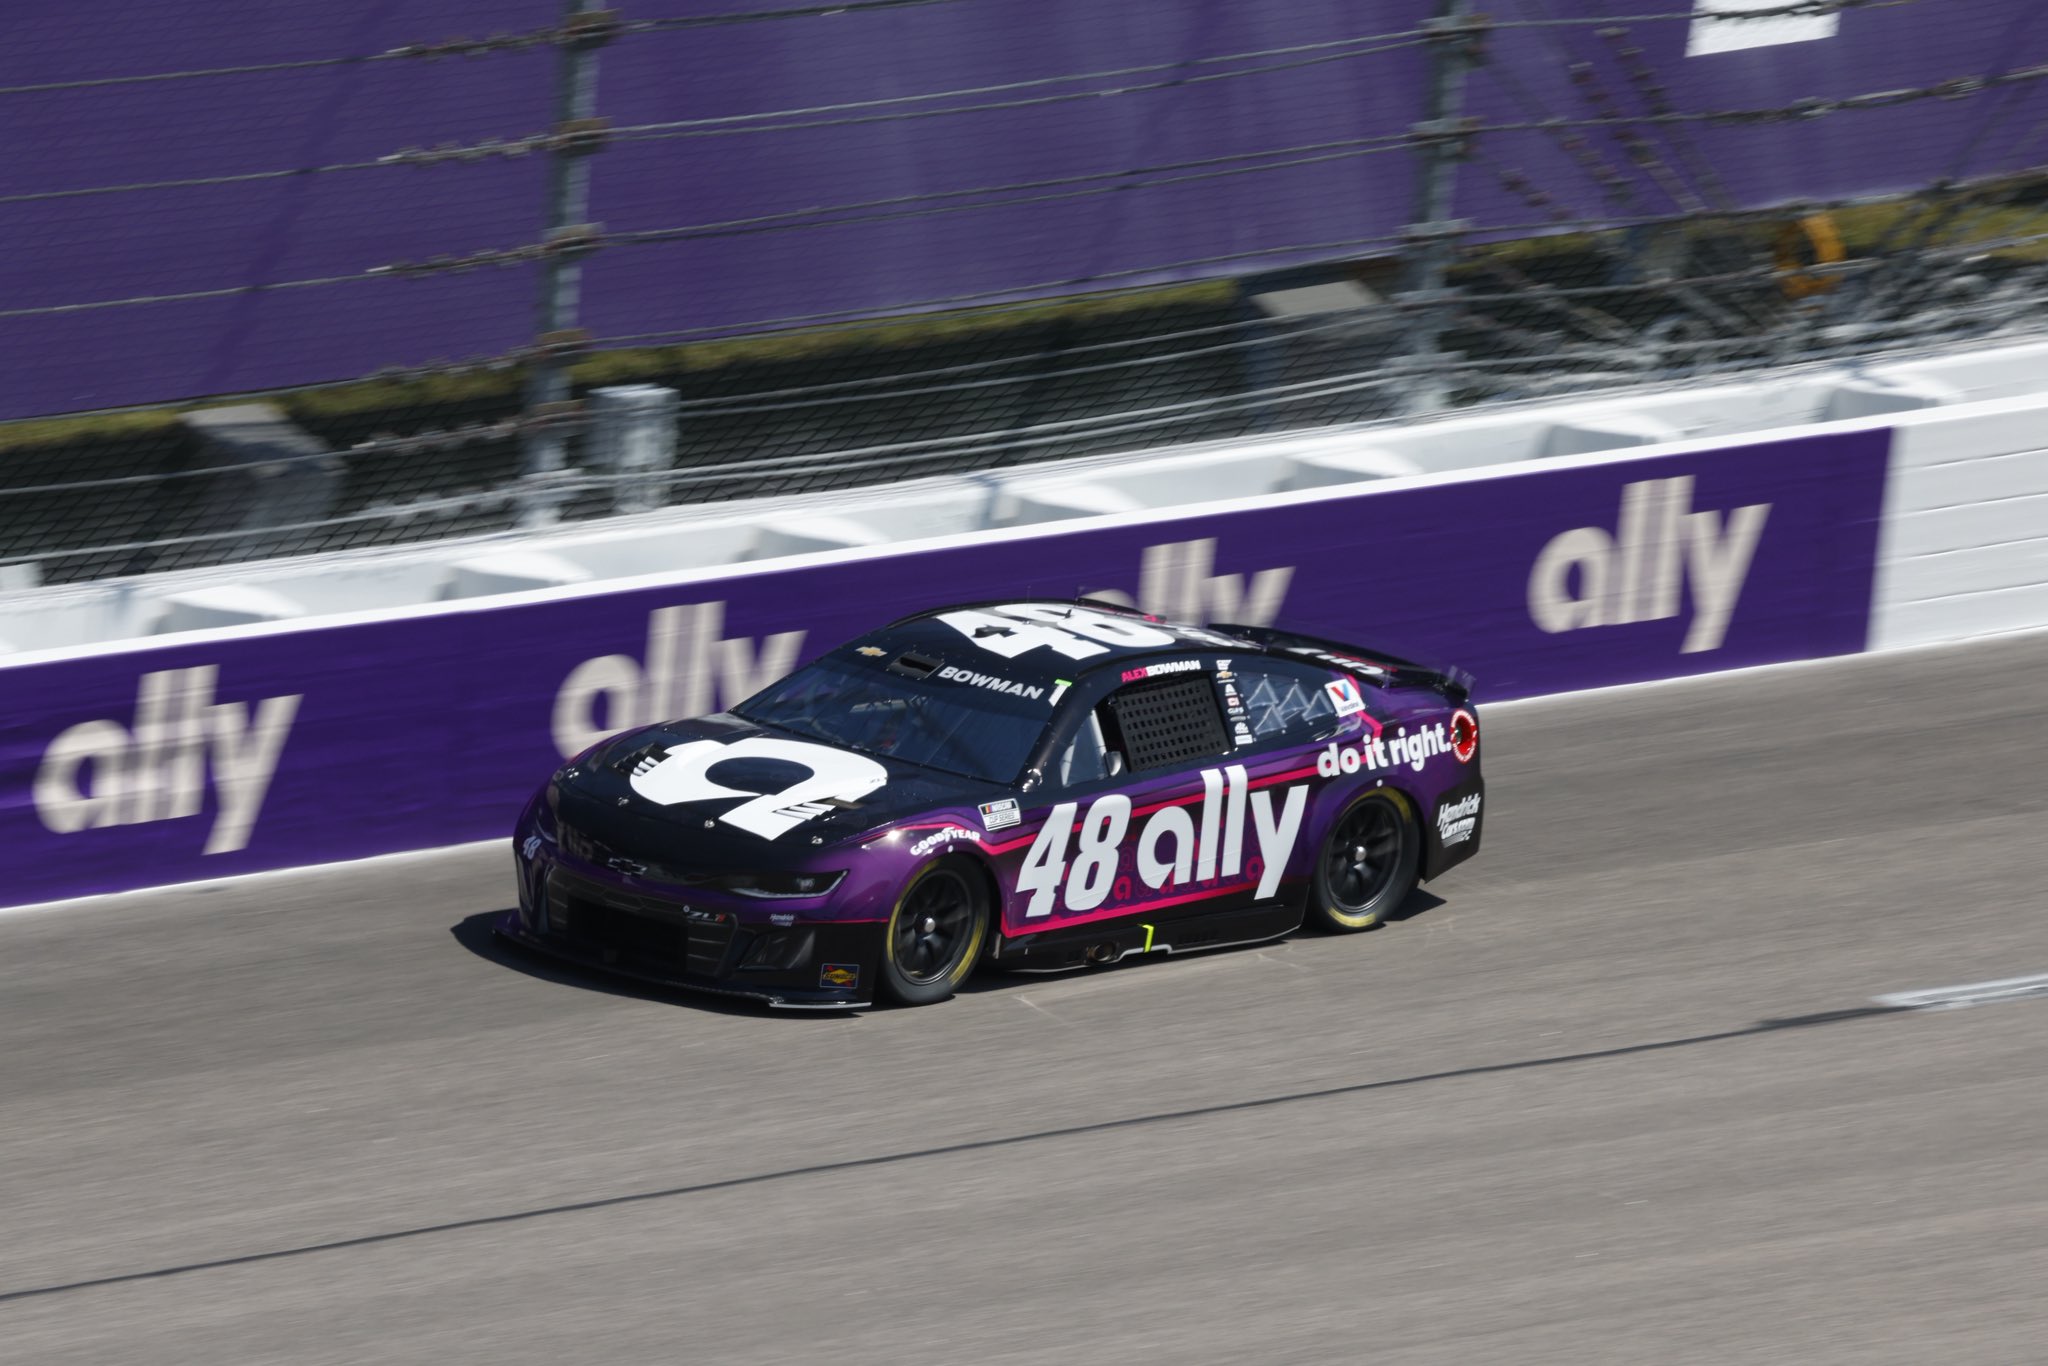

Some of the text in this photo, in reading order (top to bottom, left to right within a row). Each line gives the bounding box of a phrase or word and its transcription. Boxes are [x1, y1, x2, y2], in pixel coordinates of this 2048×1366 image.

[1082, 537, 1296, 628] ll
[1527, 475, 1772, 654] ally
[936, 603, 1176, 660] 48
[938, 666, 1045, 700] BOWMAN
[33, 663, 304, 856] ally
[1317, 742, 1361, 778] do
[1363, 734, 1389, 770] it
[1388, 722, 1452, 772] right.
[1436, 792, 1481, 832] Hendrick
[910, 827, 981, 856] GOODYEAR
[1015, 764, 1310, 918] 48 ally
